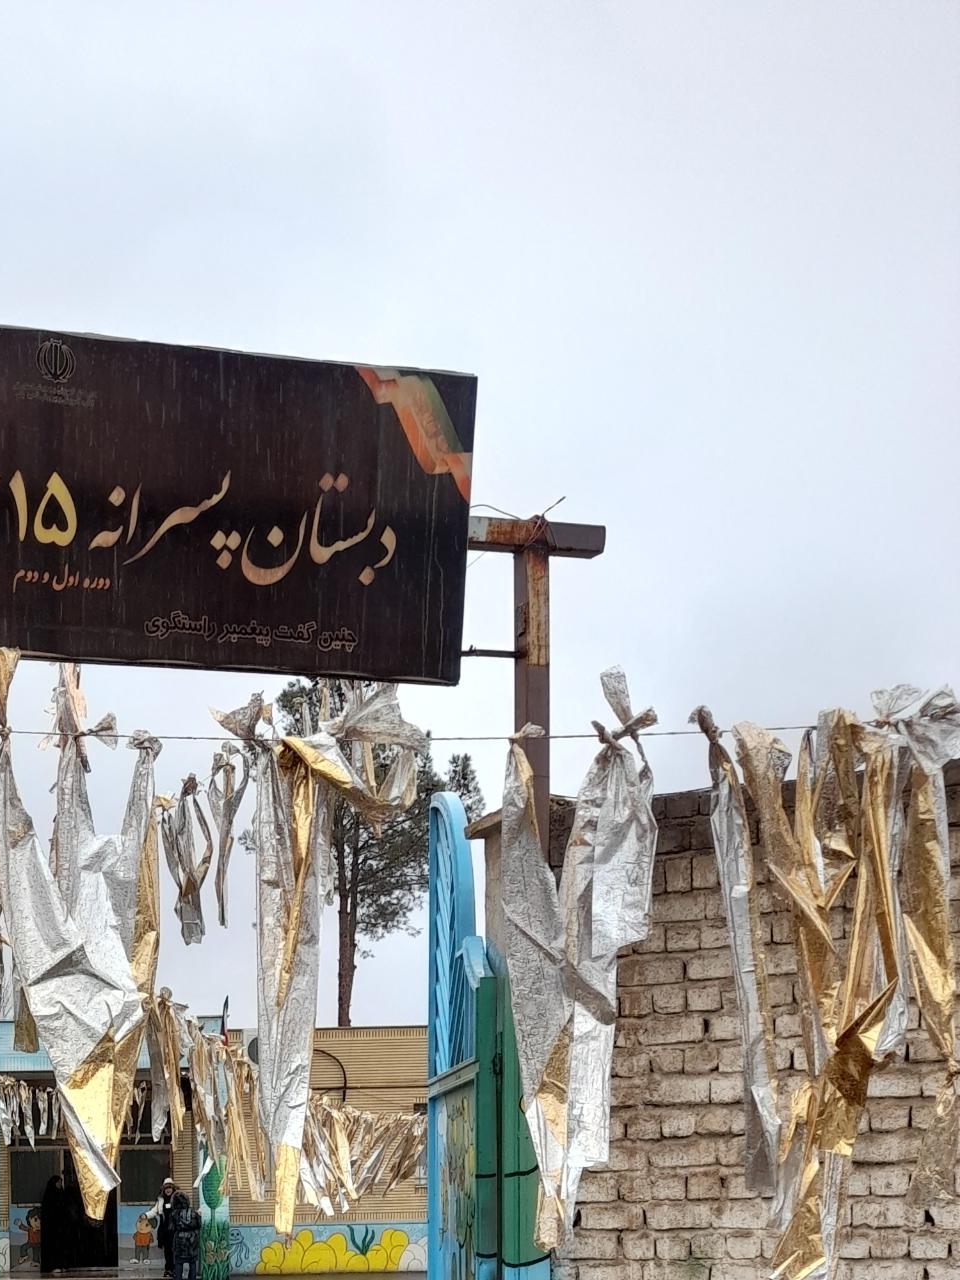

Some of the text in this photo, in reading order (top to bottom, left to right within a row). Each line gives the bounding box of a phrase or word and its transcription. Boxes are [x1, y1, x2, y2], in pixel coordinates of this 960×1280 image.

[8, 469, 79, 548] ۱۵
[88, 469, 242, 570] پسرانه
[241, 472, 397, 587] دبستان
[12, 562, 111, 594] دوره اول و دوم
[143, 610, 359, 653] چنین گفت پیغمبر راستگوی
